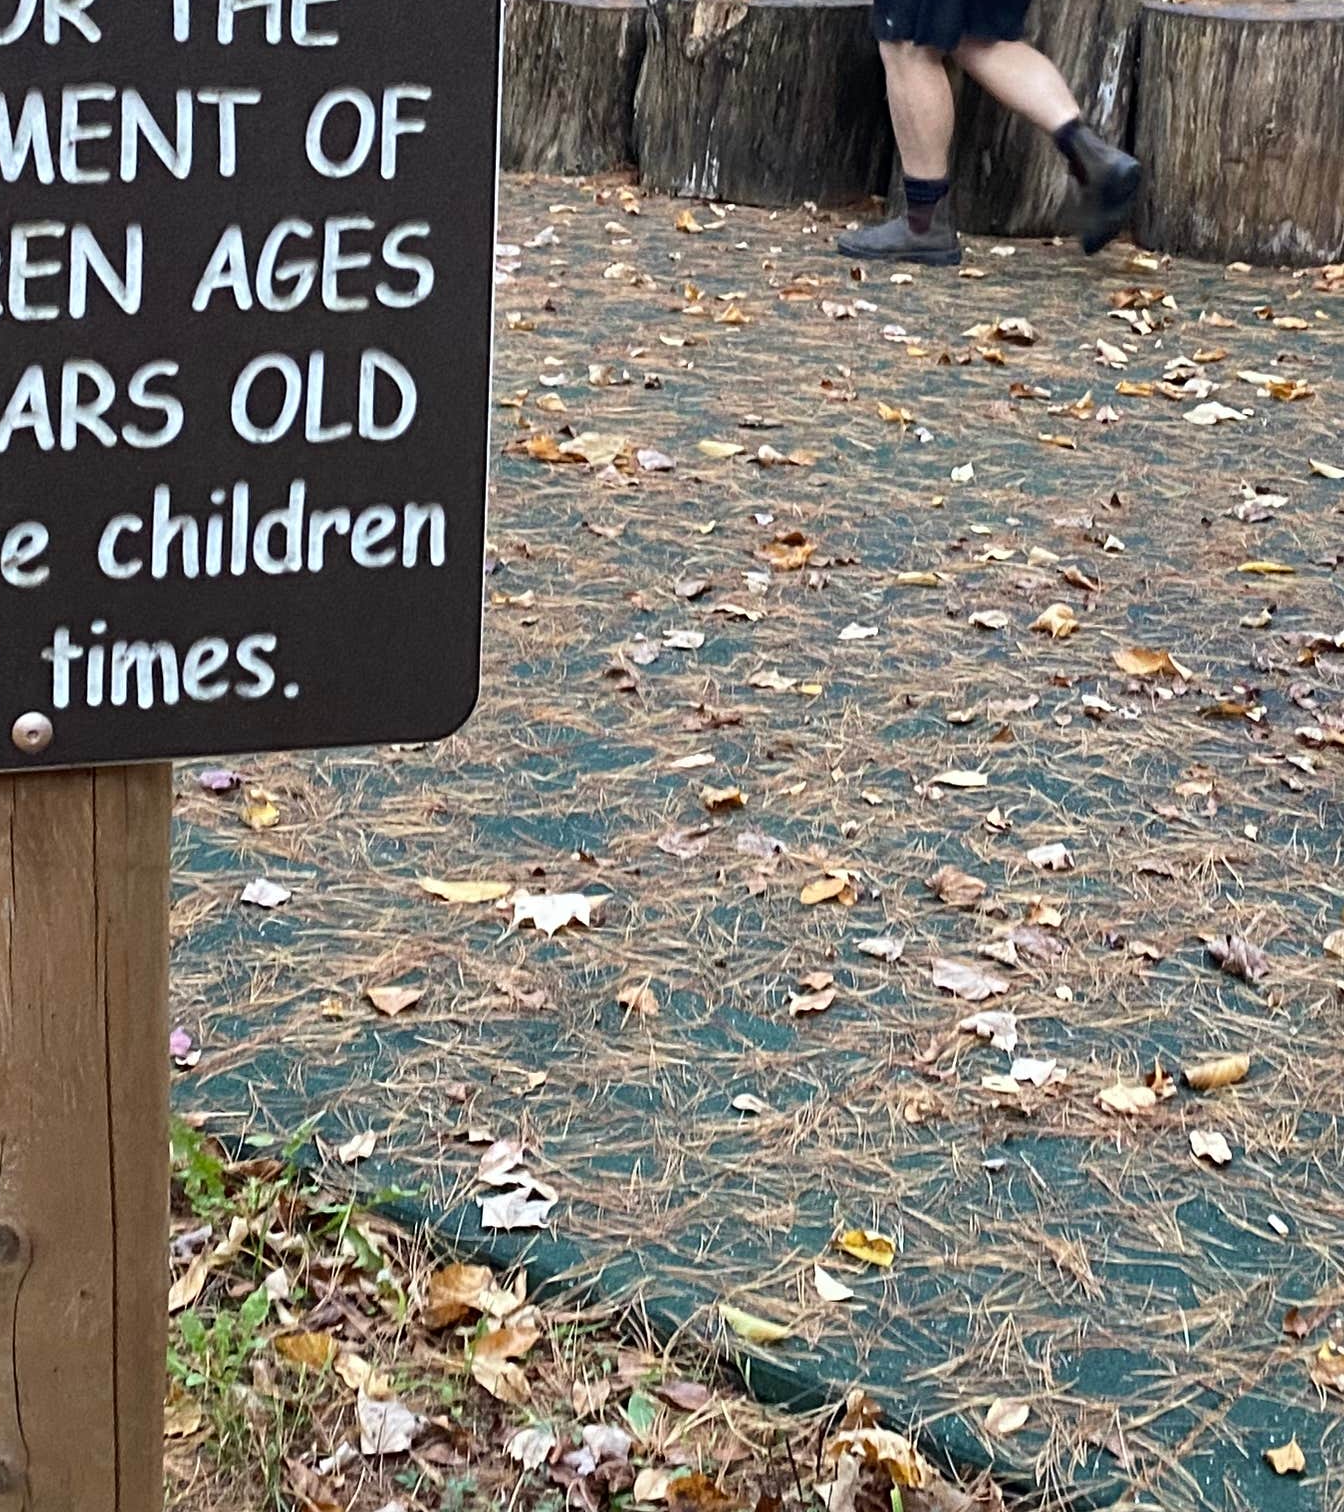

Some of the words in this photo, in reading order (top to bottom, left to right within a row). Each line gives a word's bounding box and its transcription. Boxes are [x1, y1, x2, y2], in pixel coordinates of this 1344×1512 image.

[305, 86, 432, 181] OF
[191, 216, 435, 313] AGES
[230, 351, 417, 444] OLD
[97, 480, 446, 580] children
[41, 619, 299, 710] times.
